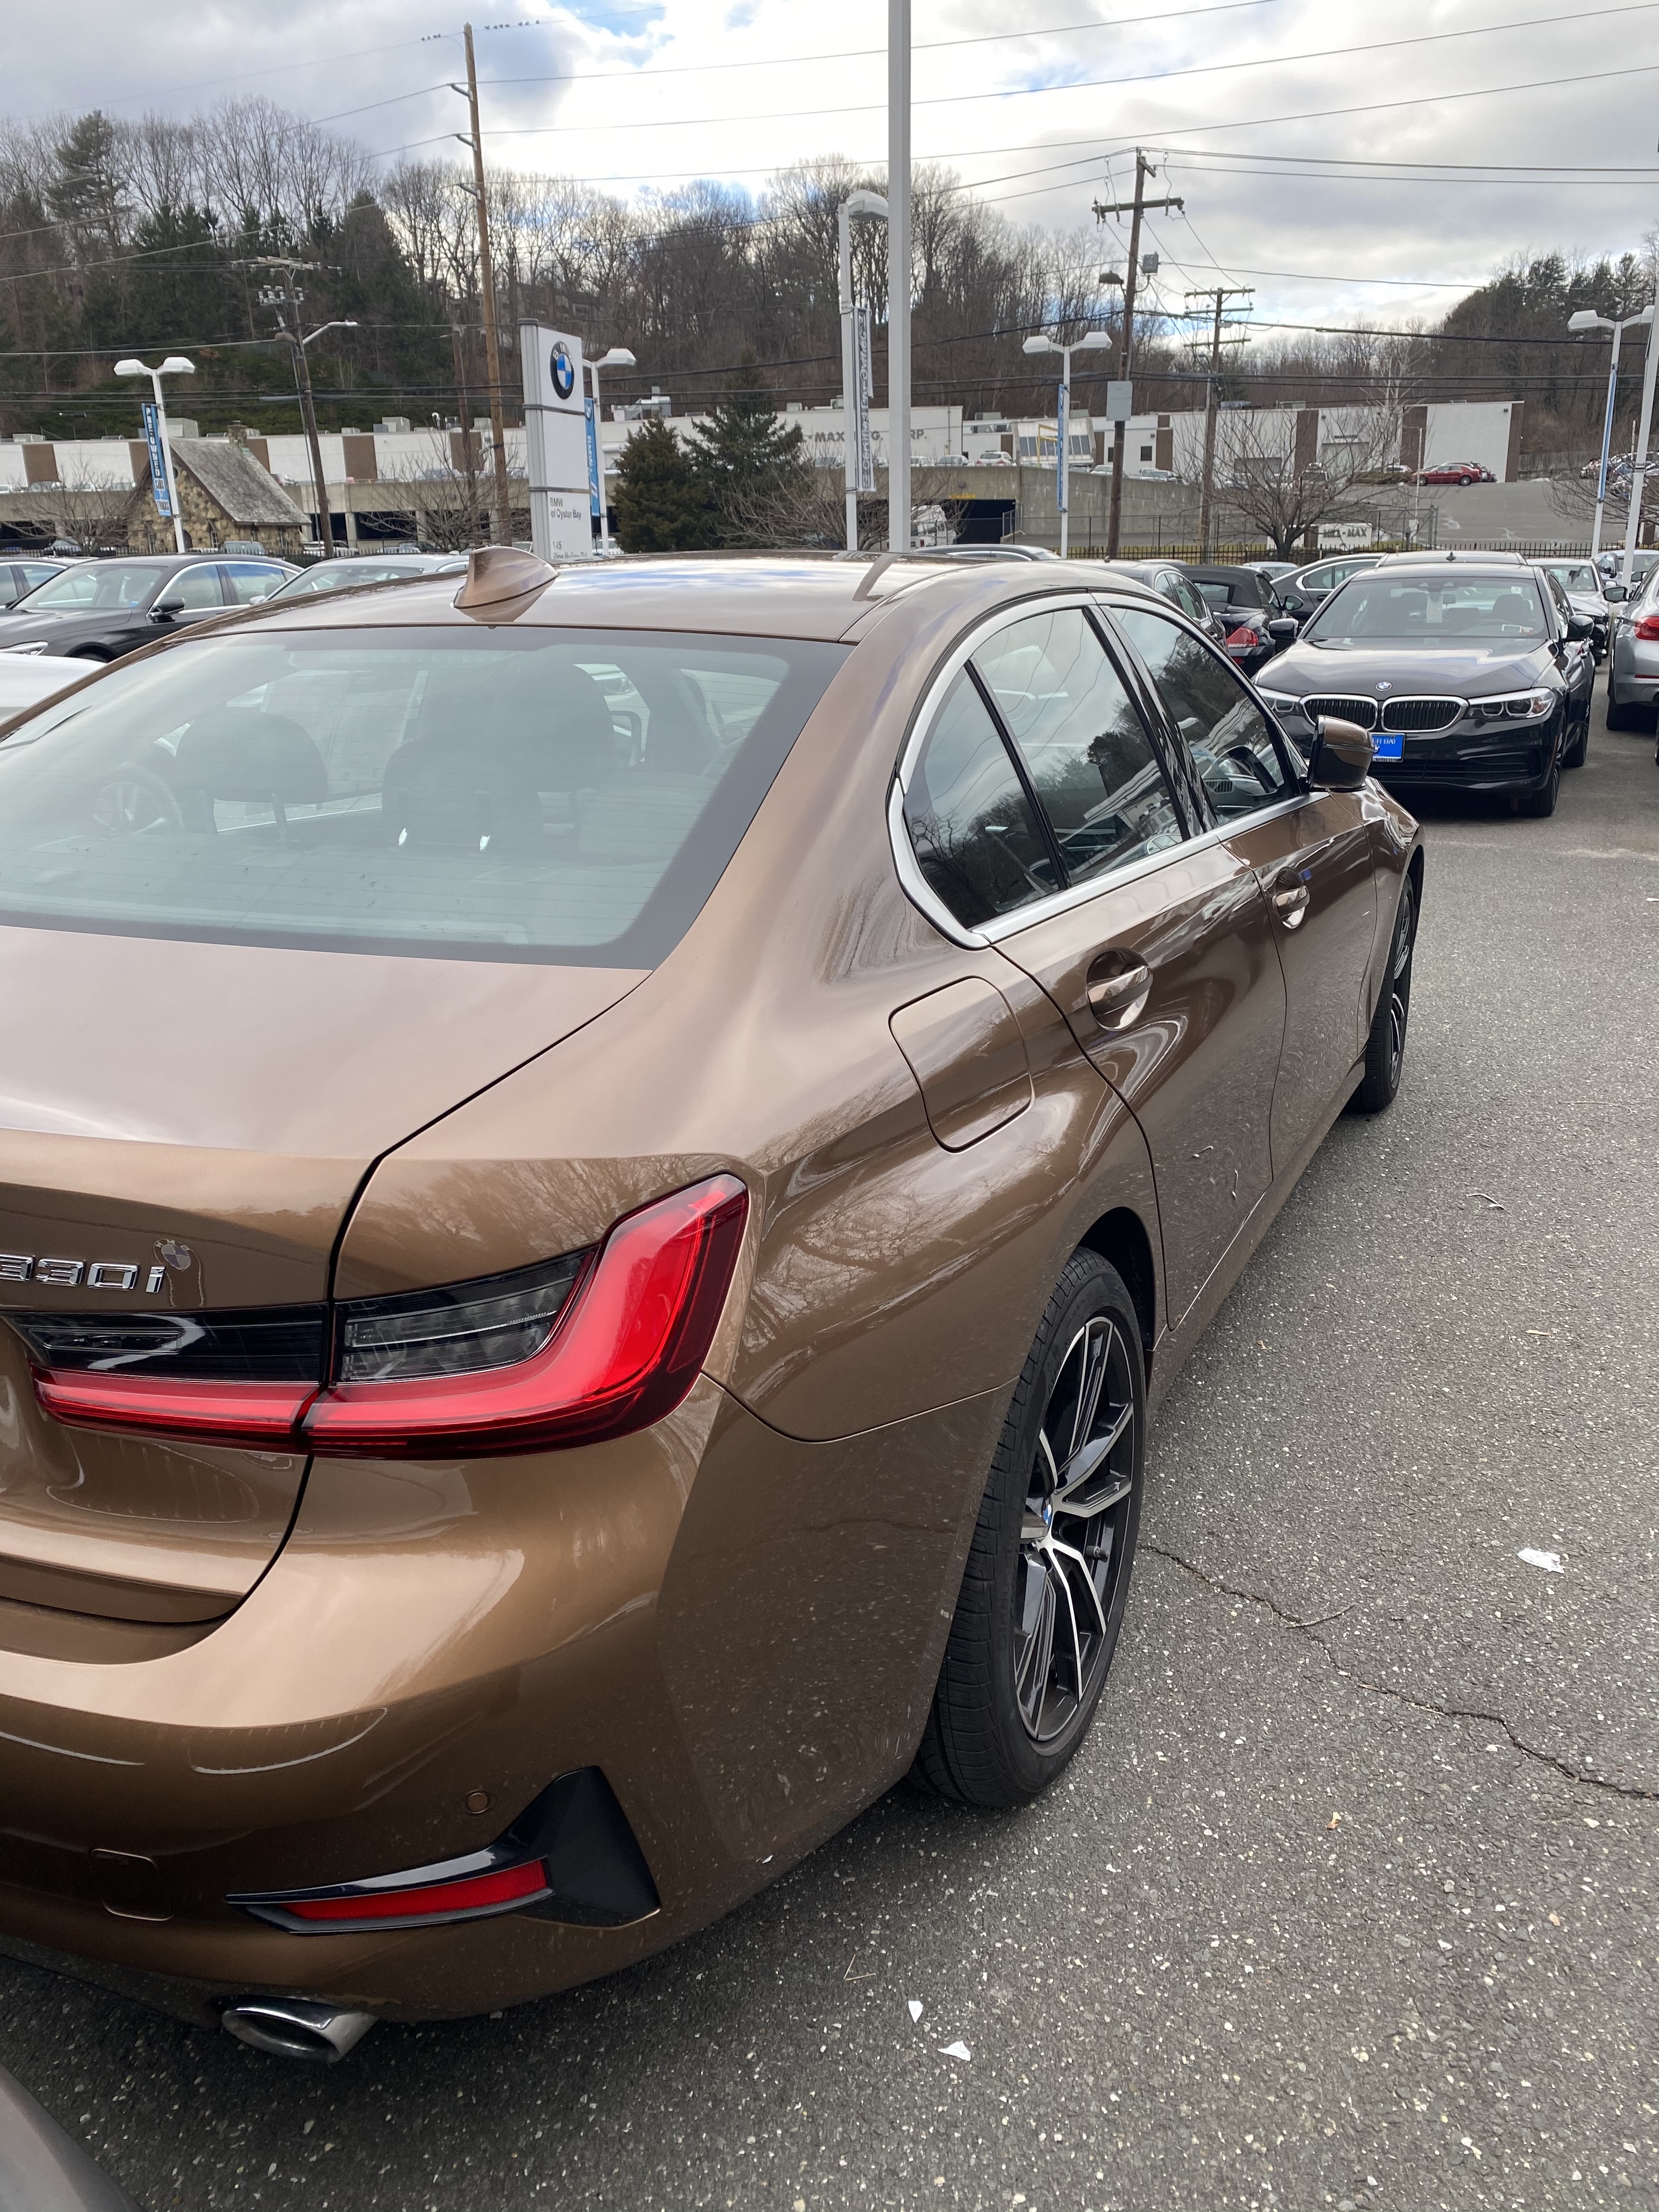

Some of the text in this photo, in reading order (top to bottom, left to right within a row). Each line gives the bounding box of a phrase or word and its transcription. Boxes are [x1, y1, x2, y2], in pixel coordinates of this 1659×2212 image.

[550, 498, 563, 507] BMW
[551, 509, 581, 520] of Oyster Bay
[553, 541, 562, 550] 145
